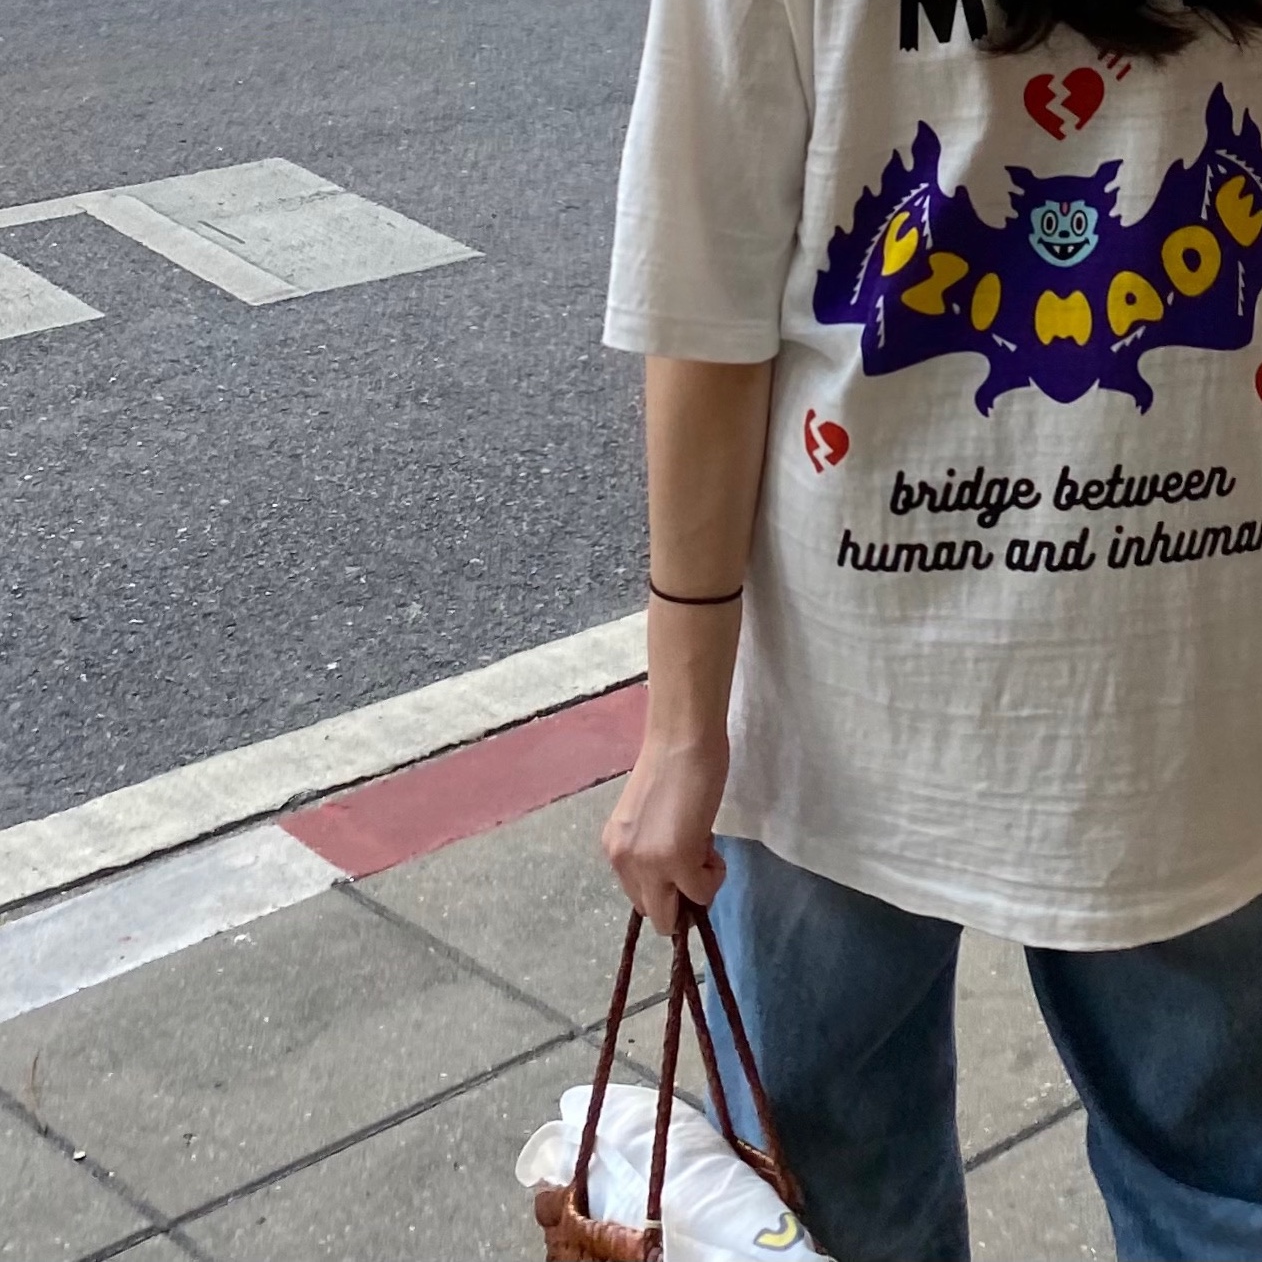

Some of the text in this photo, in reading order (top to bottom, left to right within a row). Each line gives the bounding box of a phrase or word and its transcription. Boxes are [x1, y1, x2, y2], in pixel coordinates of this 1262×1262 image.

[889, 464, 1236, 529] bridge between
[837, 530, 993, 573] human
[1005, 528, 1096, 572] and
